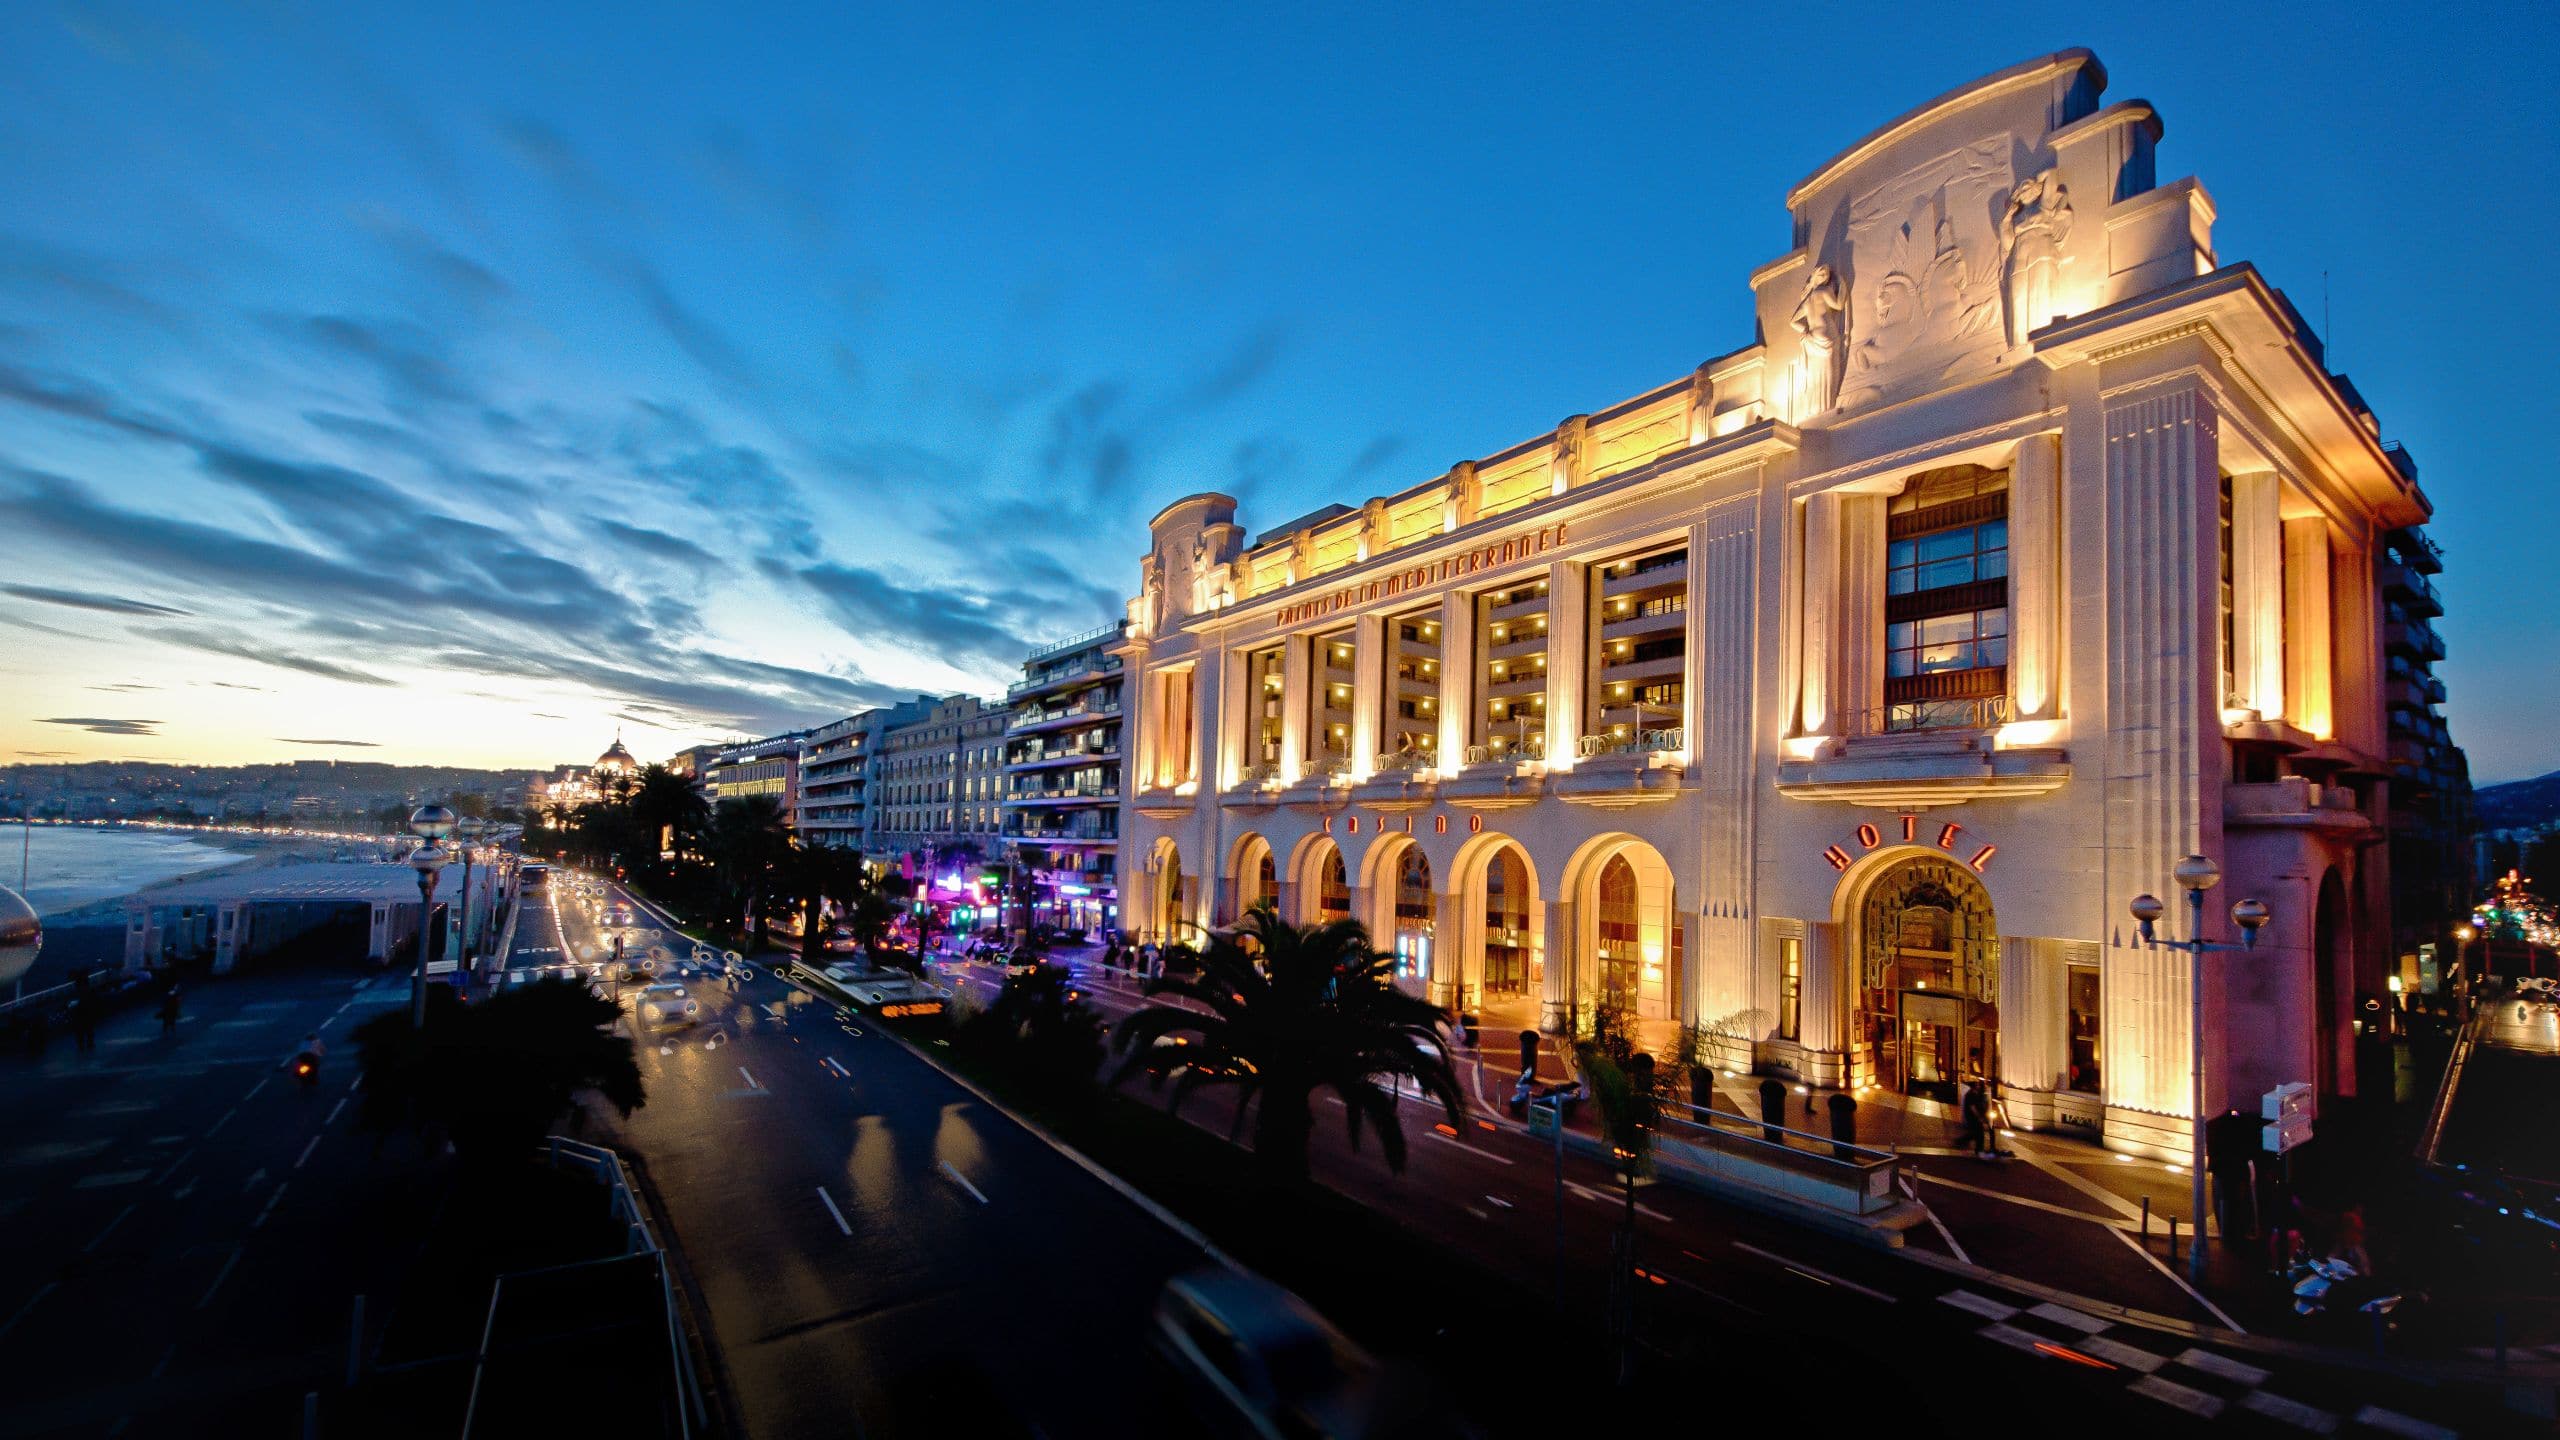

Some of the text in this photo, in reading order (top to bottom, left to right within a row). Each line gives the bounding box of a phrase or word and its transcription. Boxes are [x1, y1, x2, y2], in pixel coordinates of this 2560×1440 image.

[1277, 597, 1331, 627] PALAIS
[1336, 589, 1353, 610] DE
[1360, 583, 1380, 603] LA
[1324, 814, 1482, 834] CASINO
[1822, 815, 1997, 873] HOTEL
